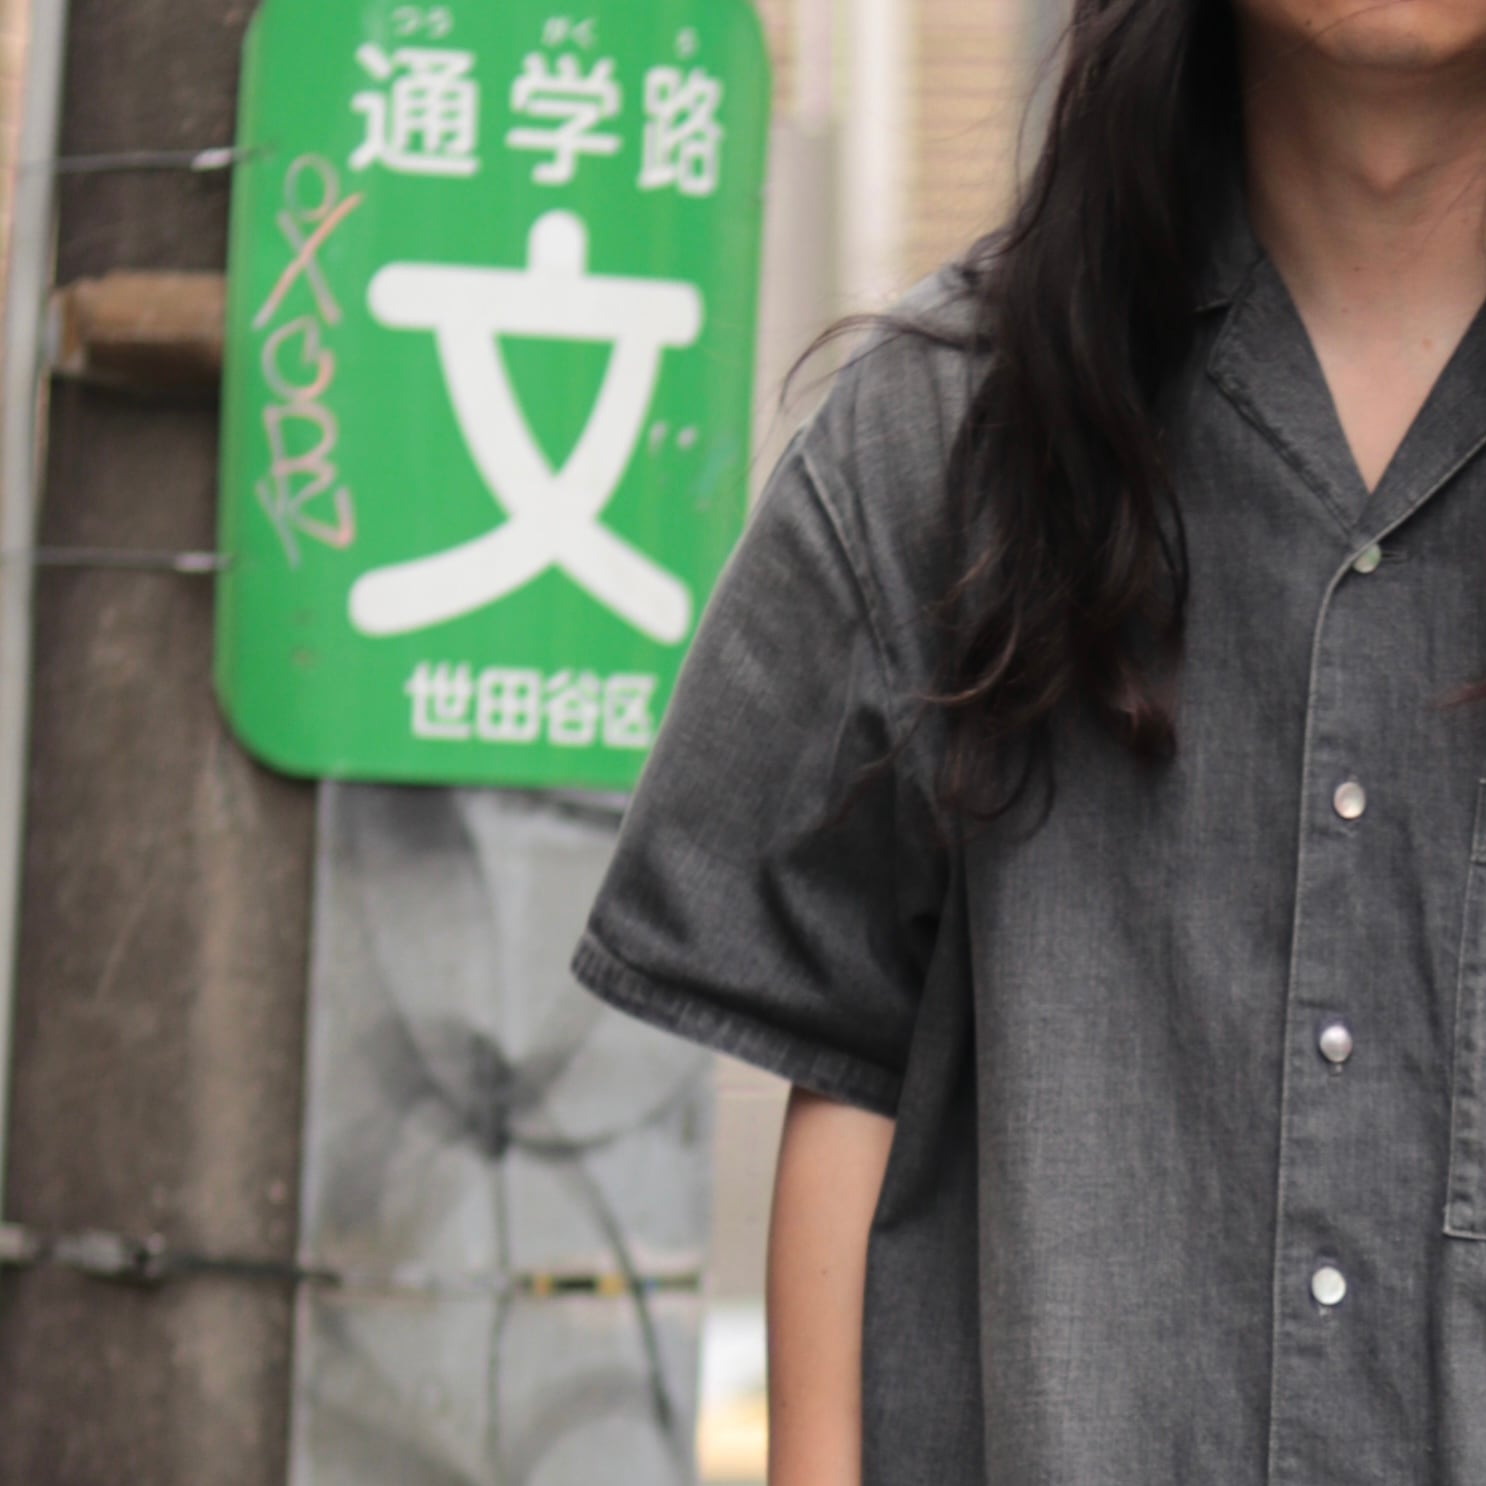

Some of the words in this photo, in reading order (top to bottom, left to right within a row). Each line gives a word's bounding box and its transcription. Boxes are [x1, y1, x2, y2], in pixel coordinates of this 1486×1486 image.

[349, 43, 723, 196] 通学路
[348, 209, 702, 645] 文
[404, 660, 657, 748] 世田谷区
